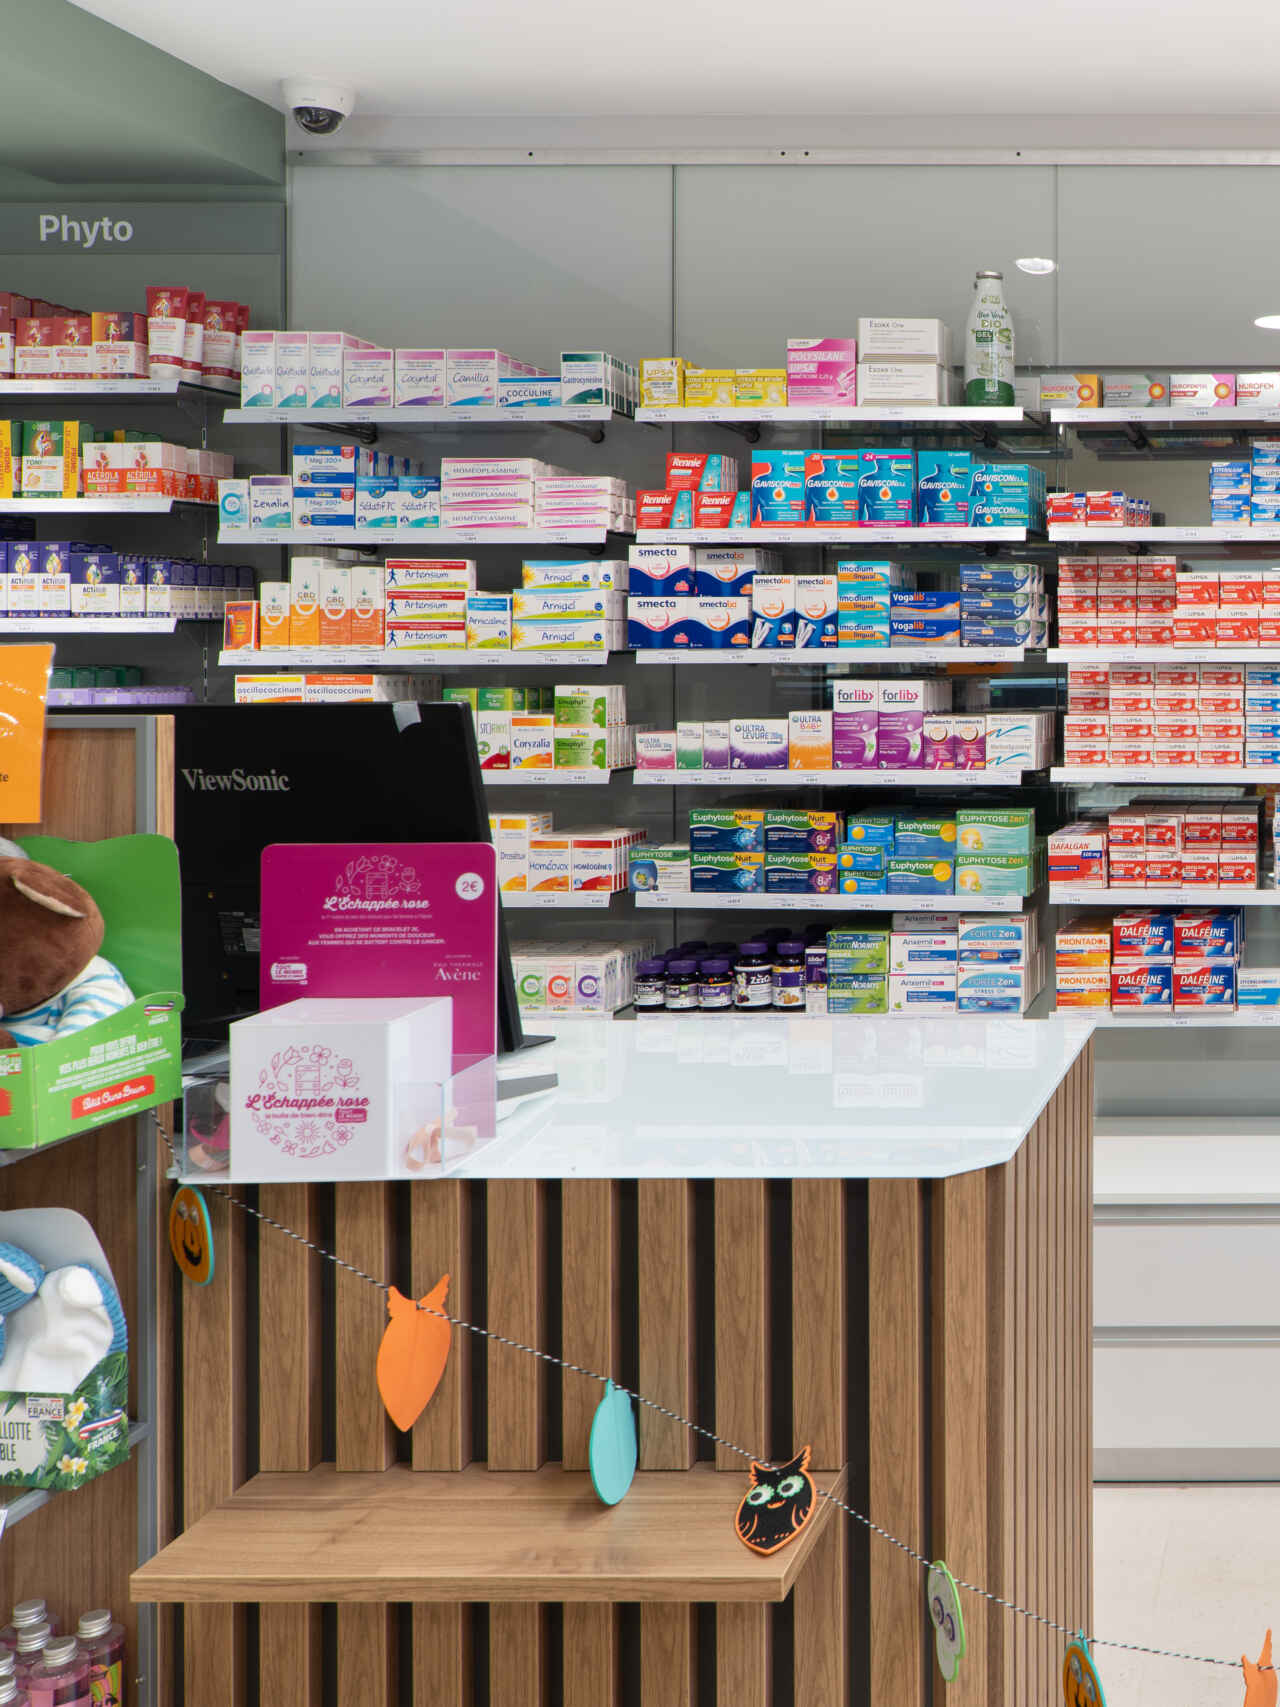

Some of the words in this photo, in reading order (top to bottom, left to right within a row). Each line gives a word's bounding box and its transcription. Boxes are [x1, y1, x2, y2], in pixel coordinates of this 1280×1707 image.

[40, 214, 133, 247] Phyto
[672, 458, 701, 467] Rennie
[643, 495, 672, 504] Rennie
[701, 497, 730, 505] Rennie
[638, 549, 676, 557] smecta
[544, 574, 573, 583] Arnigel
[893, 594, 925, 602] Vogalib
[542, 602, 575, 612] Arnigel
[637, 600, 676, 608] smecta
[893, 622, 925, 630] Vogalib
[542, 633, 574, 643] Arnigel
[308, 687, 371, 695] oscillococcinum
[514, 738, 550, 749] Coryzalia
[182, 768, 290, 791] ViewSonic
[693, 814, 734, 822] Euphytose
[767, 814, 808, 822] Euphytose
[898, 822, 940, 831] Euphytose
[694, 855, 734, 863] Euphytose
[736, 855, 752, 863] Nuit
[890, 862, 933, 871] Euphytose
[462, 881, 478, 892] 2€
[401, 900, 430, 909] rose
[1120, 926, 1164, 936] DALFÉINE
[1182, 927, 1225, 937] DALFÉINE
[903, 938, 933, 946] Anxemil
[434, 967, 481, 981] Avène
[1118, 975, 1162, 985] DALFÉINE
[1180, 975, 1224, 985] DALFÉINE
[245, 1092, 334, 1110] L'Échappée
[337, 1096, 370, 1108] rose
[28, 1408, 62, 1416] FRANCE
